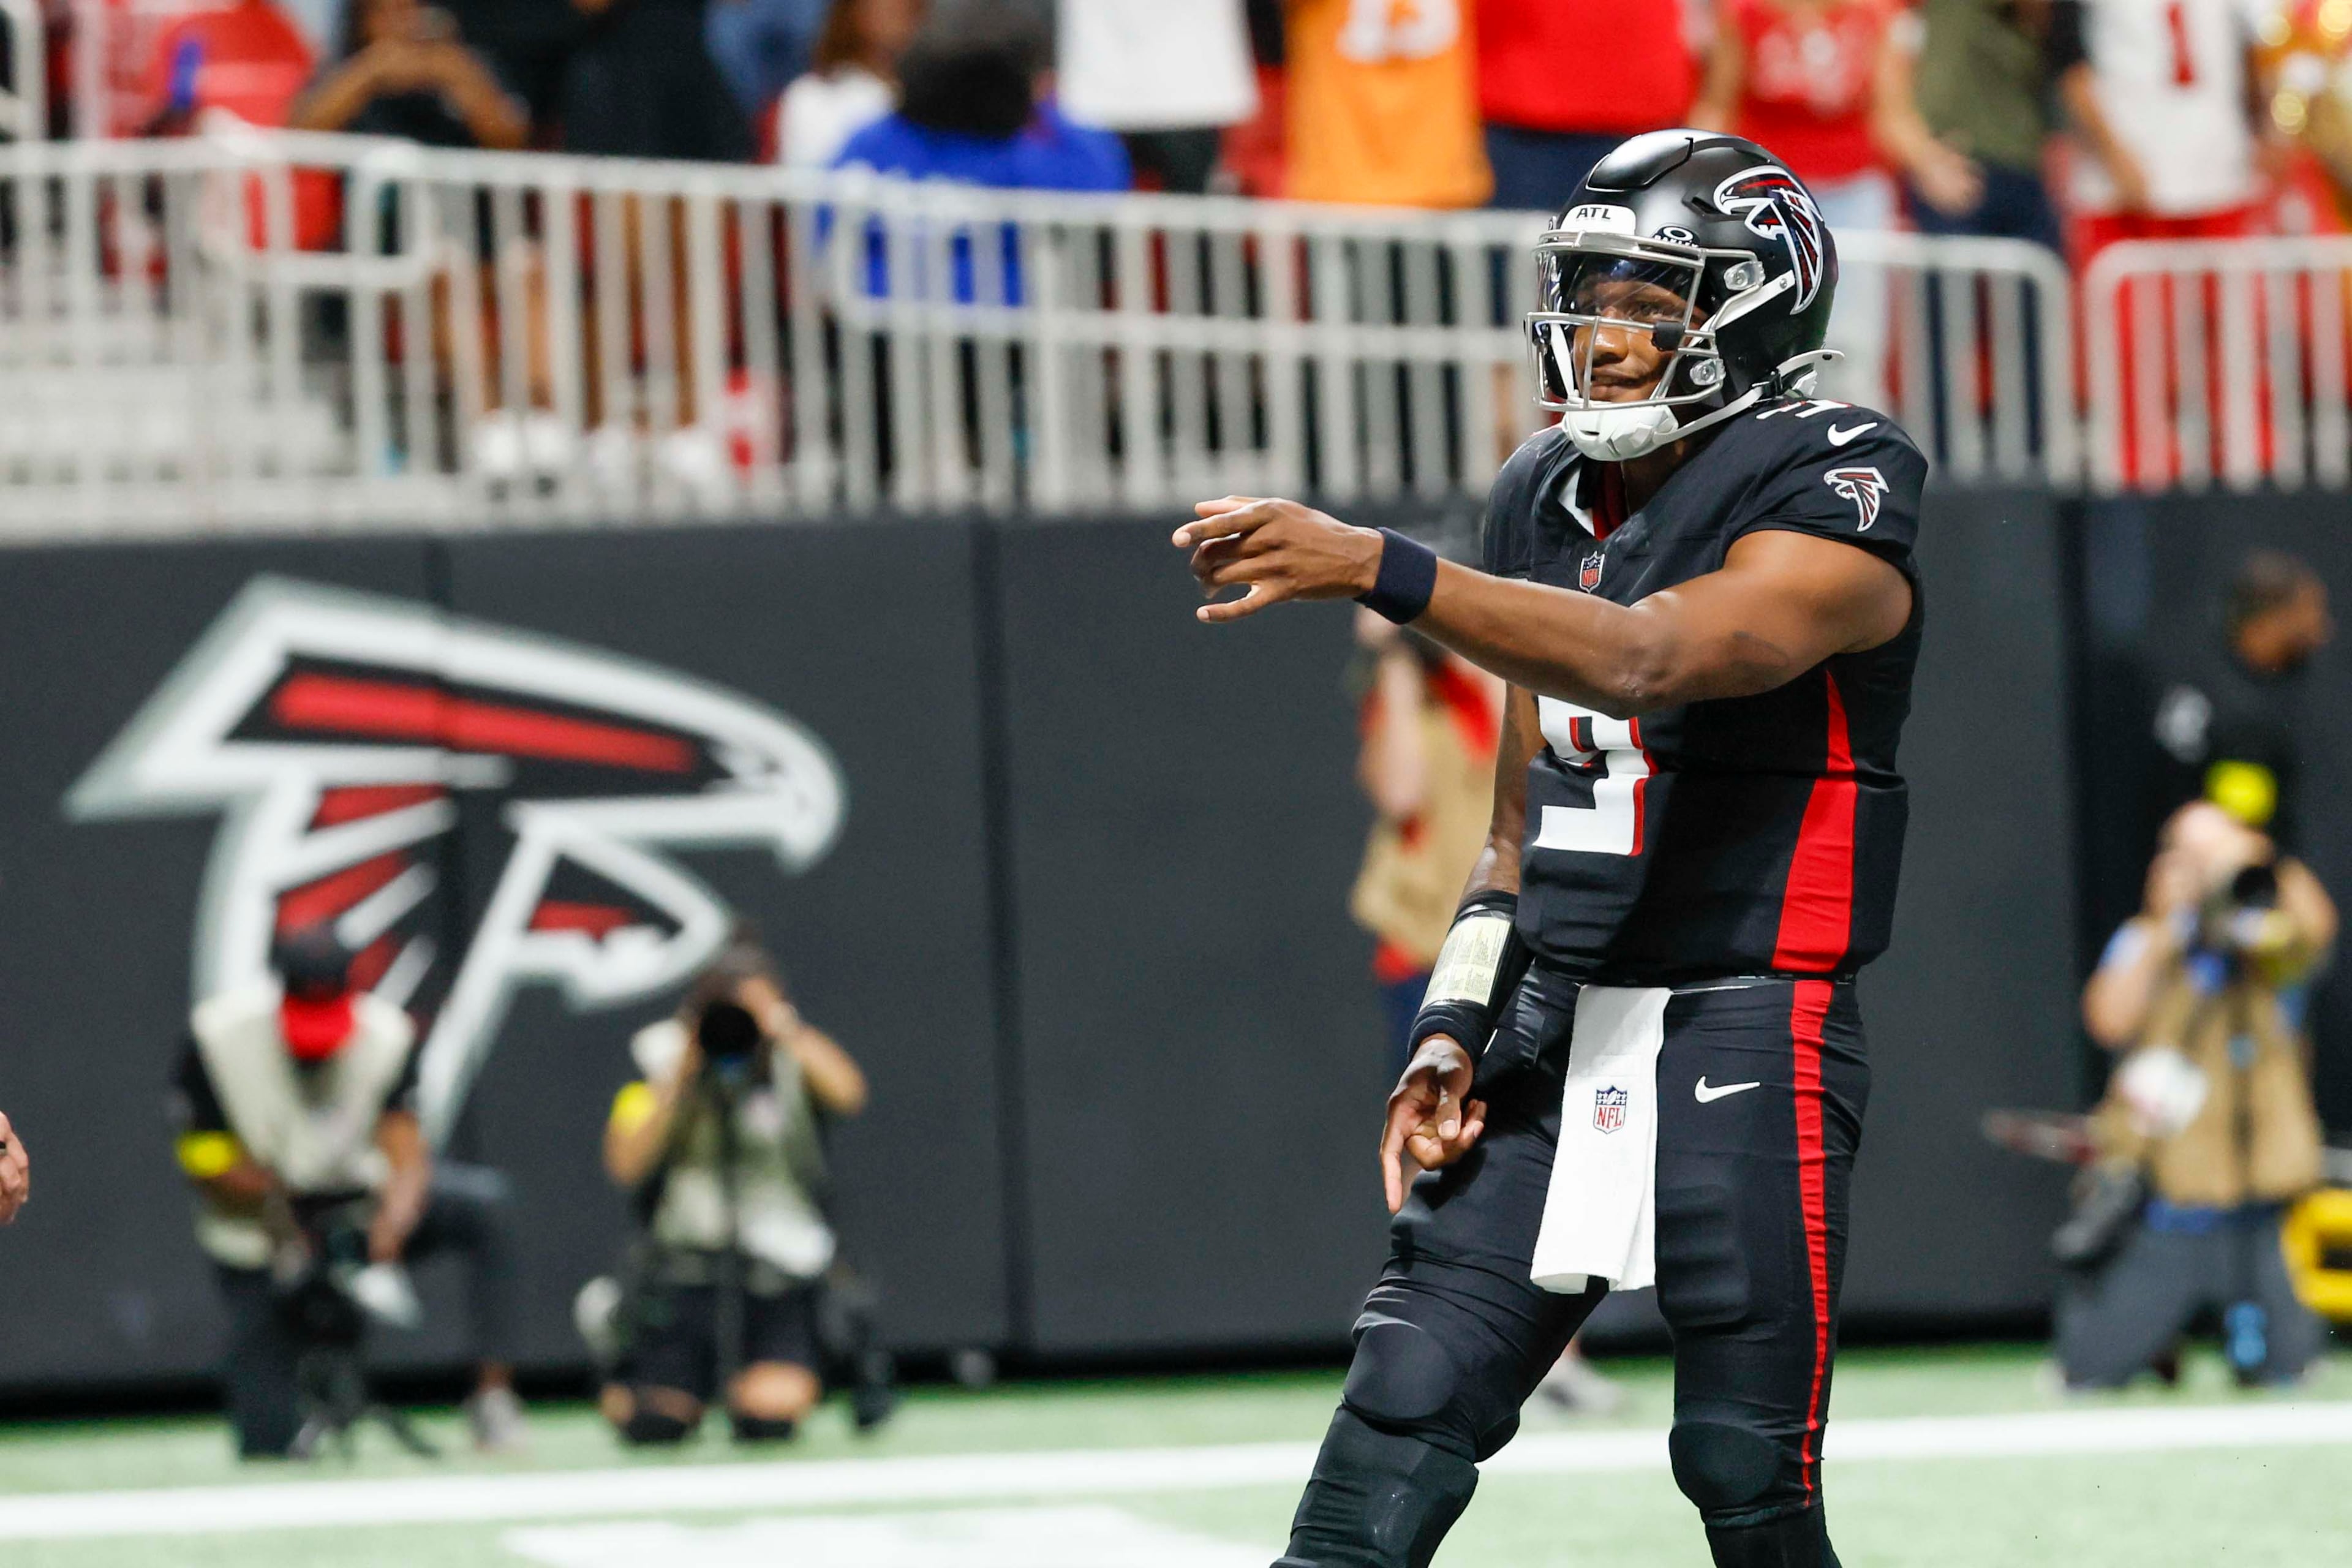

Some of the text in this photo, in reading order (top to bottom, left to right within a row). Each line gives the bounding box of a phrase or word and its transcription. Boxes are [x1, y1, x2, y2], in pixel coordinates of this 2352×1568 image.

[1576, 207, 1611, 220] ATL
[1583, 570, 1598, 586] NFL
[1596, 1107, 1622, 1129] NFL
